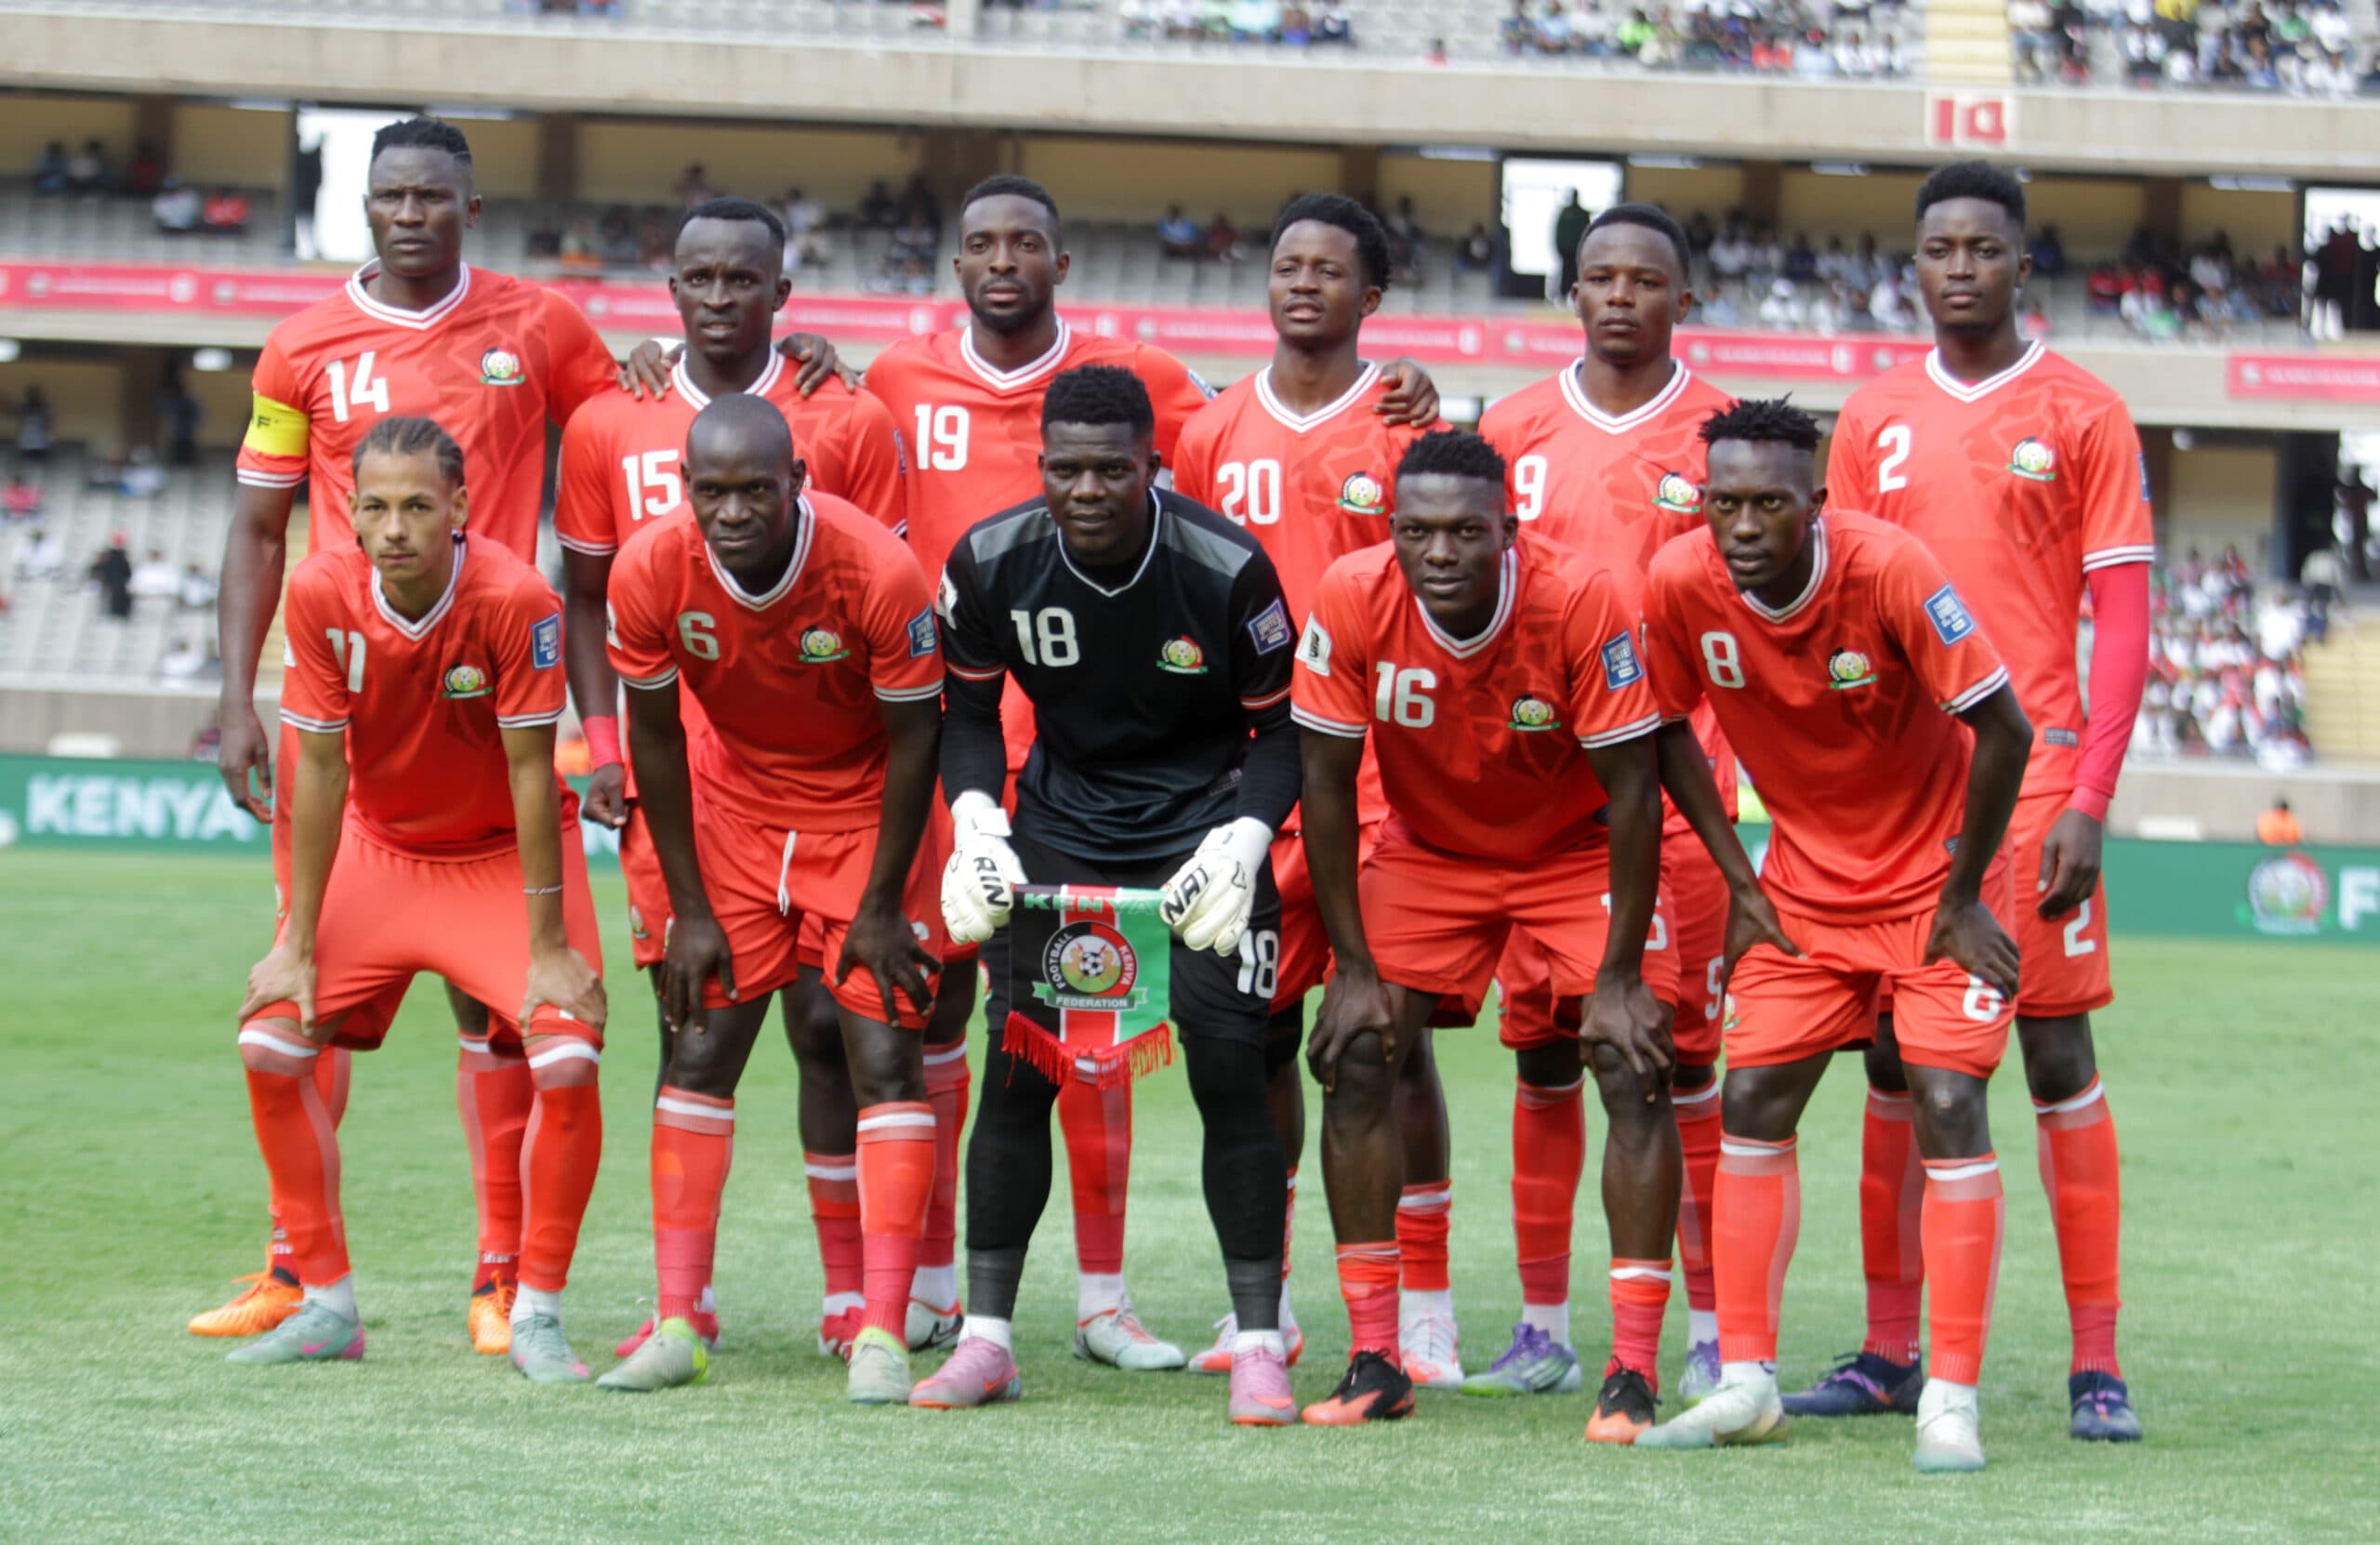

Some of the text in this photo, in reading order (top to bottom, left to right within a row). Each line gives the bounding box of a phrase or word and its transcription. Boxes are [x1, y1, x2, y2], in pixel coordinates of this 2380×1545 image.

[325, 350, 390, 422] 14
[915, 404, 970, 470] 19
[1877, 424, 1911, 493] 2
[622, 450, 683, 521] 15
[1217, 458, 1281, 526] 20
[1514, 454, 1548, 522] 9
[325, 627, 366, 693] 11
[678, 612, 721, 660] 6
[1011, 606, 1080, 667] 18
[1700, 631, 1745, 688] 8
[1376, 661, 1436, 728] 16
[26, 773, 257, 841] KENYA
[1024, 891, 1156, 915] KENYA
[2063, 898, 2096, 957] 2
[1048, 932, 1074, 990] FOOTBALL
[1118, 944, 1136, 985] KENYA
[1236, 928, 1279, 999] 18
[1055, 995, 1129, 1010] FEDERATION
